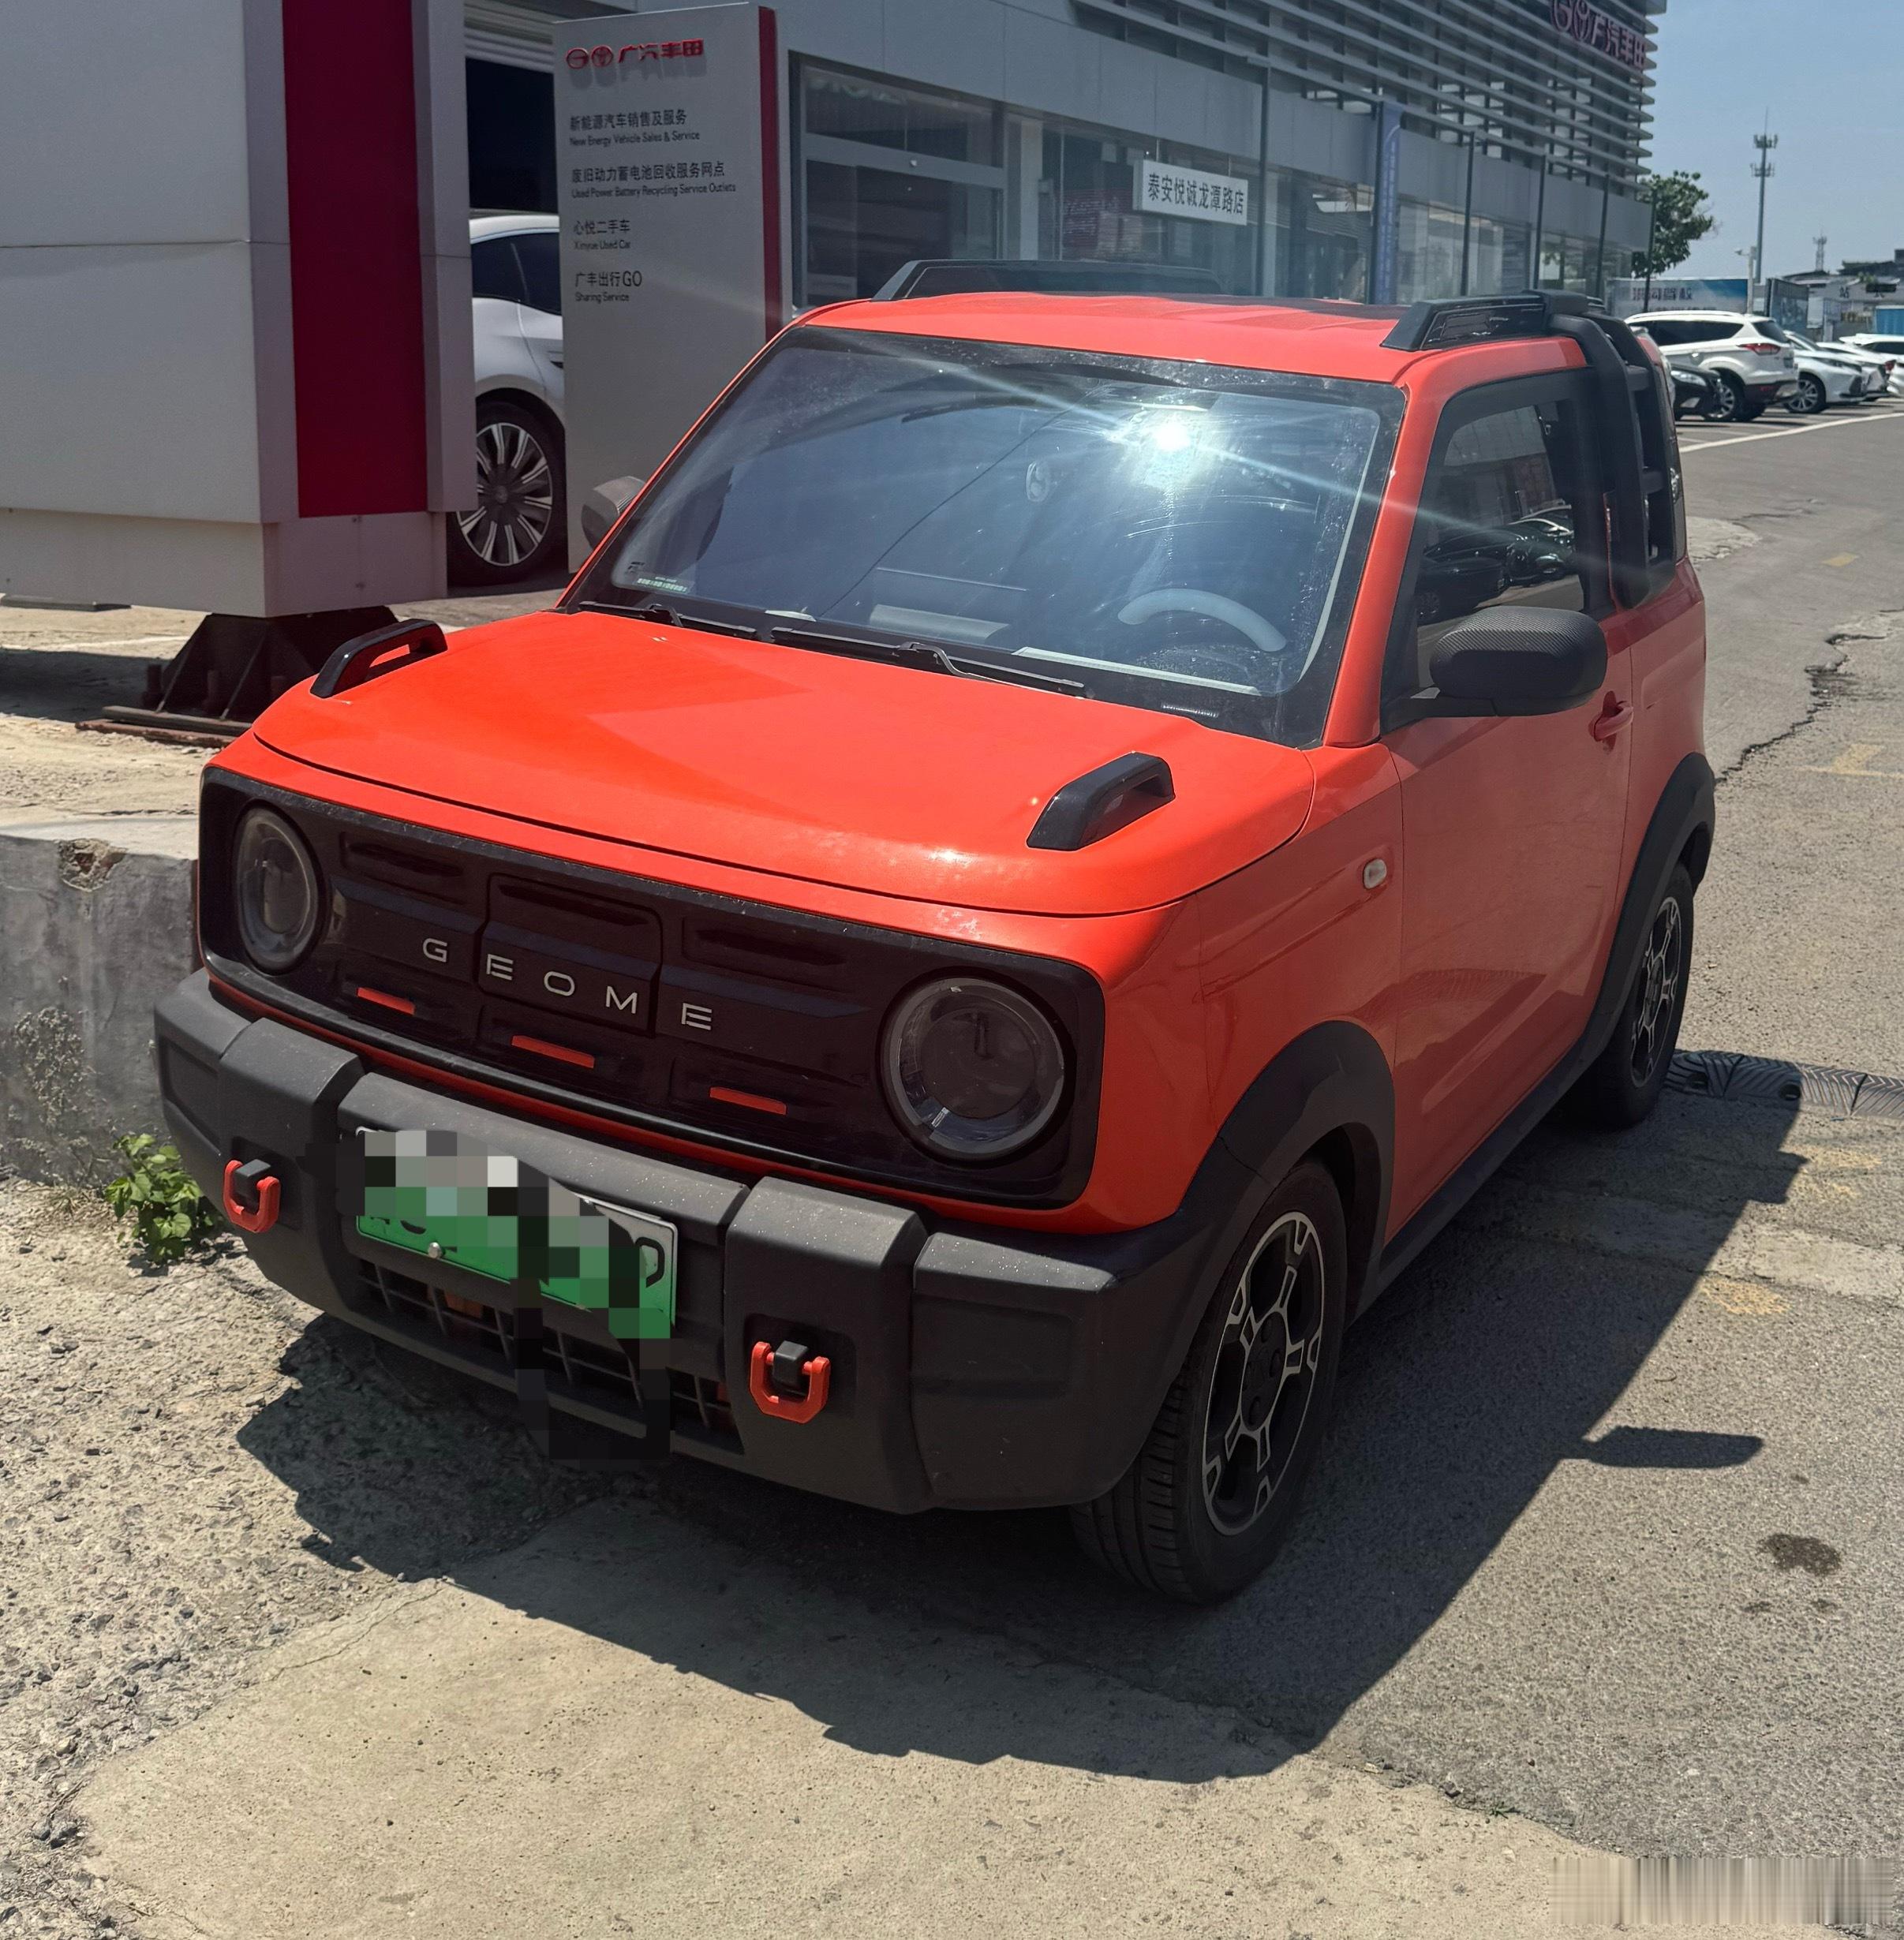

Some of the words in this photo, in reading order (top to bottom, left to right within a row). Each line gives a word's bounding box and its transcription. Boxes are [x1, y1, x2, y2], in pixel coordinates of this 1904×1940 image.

[619, 38, 704, 63] 广汽丰田
[570, 109, 686, 131] 新能源汽车销售及服务
[570, 136, 585, 146] New
[588, 134, 612, 148] Energy
[614, 134, 641, 144] Vehicle
[642, 133, 662, 144] Sales
[664, 133, 671, 142] &
[672, 130, 700, 141] Service
[571, 160, 725, 183] 废旧动力蓄电池回收服务网点
[571, 189, 590, 199] Used
[592, 188, 613, 198] Power
[615, 187, 641, 198] Battery
[642, 185, 678, 196] Recycling
[679, 183, 707, 194] Service
[709, 182, 736, 193] Outlets
[1148, 172, 1244, 215] 泰安悦诚龙潭路店
[574, 219, 630, 235] 心悦二手车
[600, 240, 618, 249] Used
[619, 239, 630, 249] Car
[575, 271, 642, 287] 广丰出行GO
[575, 292, 601, 304] Sharing
[603, 292, 630, 301] Service
[422, 937, 713, 1030] GEOME
